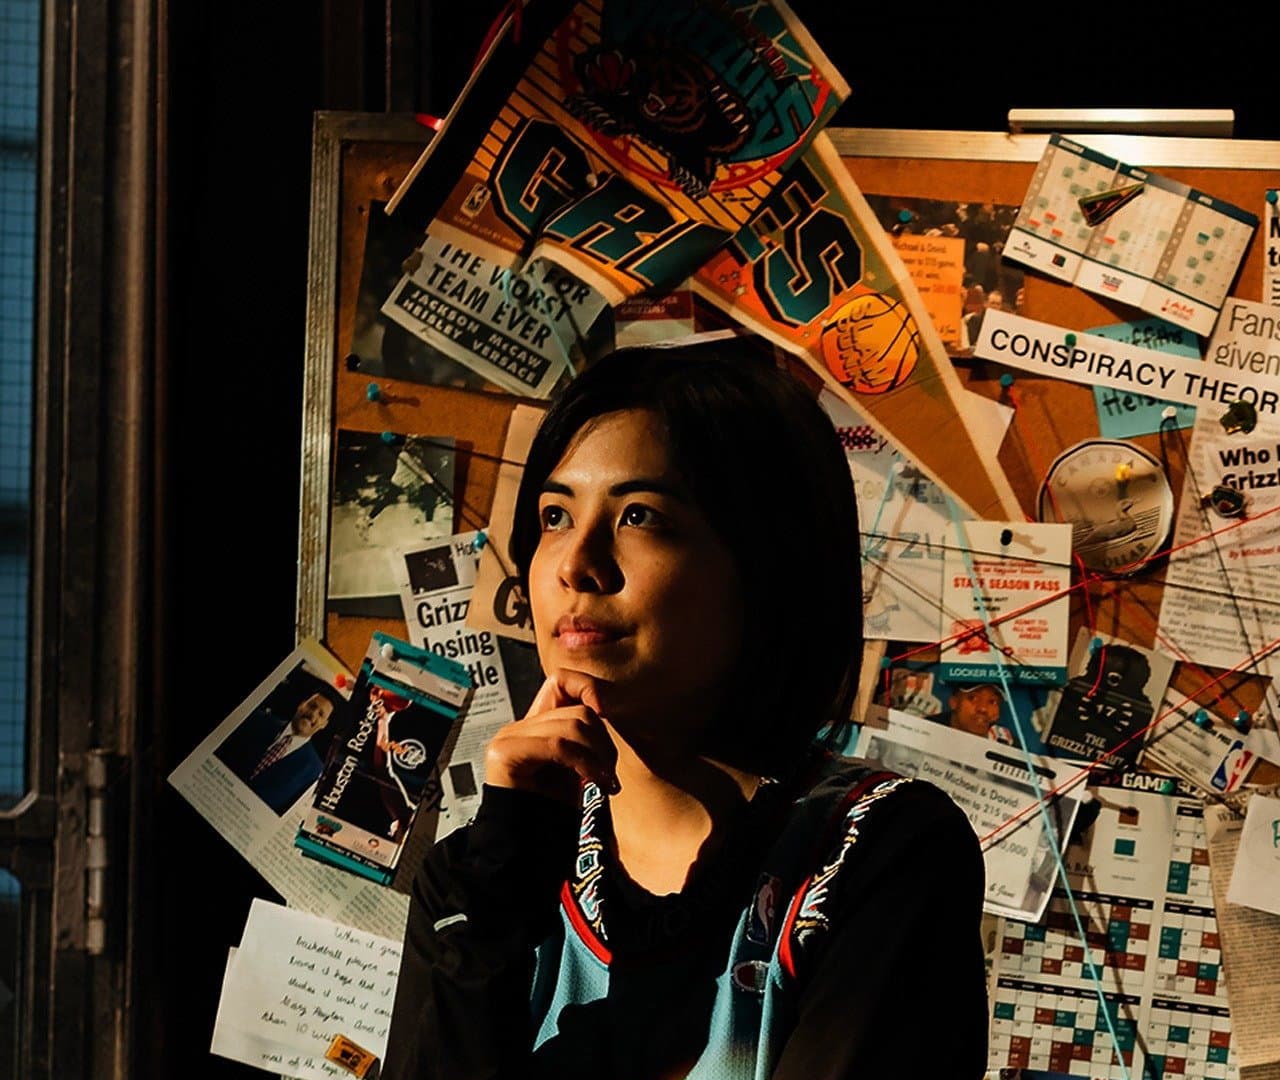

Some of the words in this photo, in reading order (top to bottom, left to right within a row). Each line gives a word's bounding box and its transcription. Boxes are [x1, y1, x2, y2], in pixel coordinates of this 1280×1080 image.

[439, 243, 486, 277] THE
[489, 264, 573, 322] WORST
[542, 265, 591, 304] FOR
[410, 288, 480, 335] JACKSON
[426, 262, 491, 316] TEAM
[492, 302, 552, 349] EVER
[471, 339, 538, 385] VERSACE
[990, 328, 1177, 389] CONSPIRACY
[1219, 447, 1270, 468] Who
[953, 577, 985, 589] STAF
[989, 579, 1030, 590] SEASON
[1033, 580, 1061, 592] PASS
[423, 629, 495, 660] losing
[948, 667, 987, 678] LOCKER
[1019, 670, 1057, 681] ACCESS
[347, 697, 384, 753] Rockets
[1095, 702, 1117, 718] 17
[1049, 734, 1094, 759] GRIZZLY
[1084, 731, 1107, 750] THE
[320, 751, 363, 811] Houston
[922, 761, 943, 777] Dear
[944, 770, 980, 794] Michael
[989, 789, 1019, 809] David
[971, 801, 980, 811] to
[983, 803, 1000, 817] 215
[296, 1023, 309, 1034] 10
